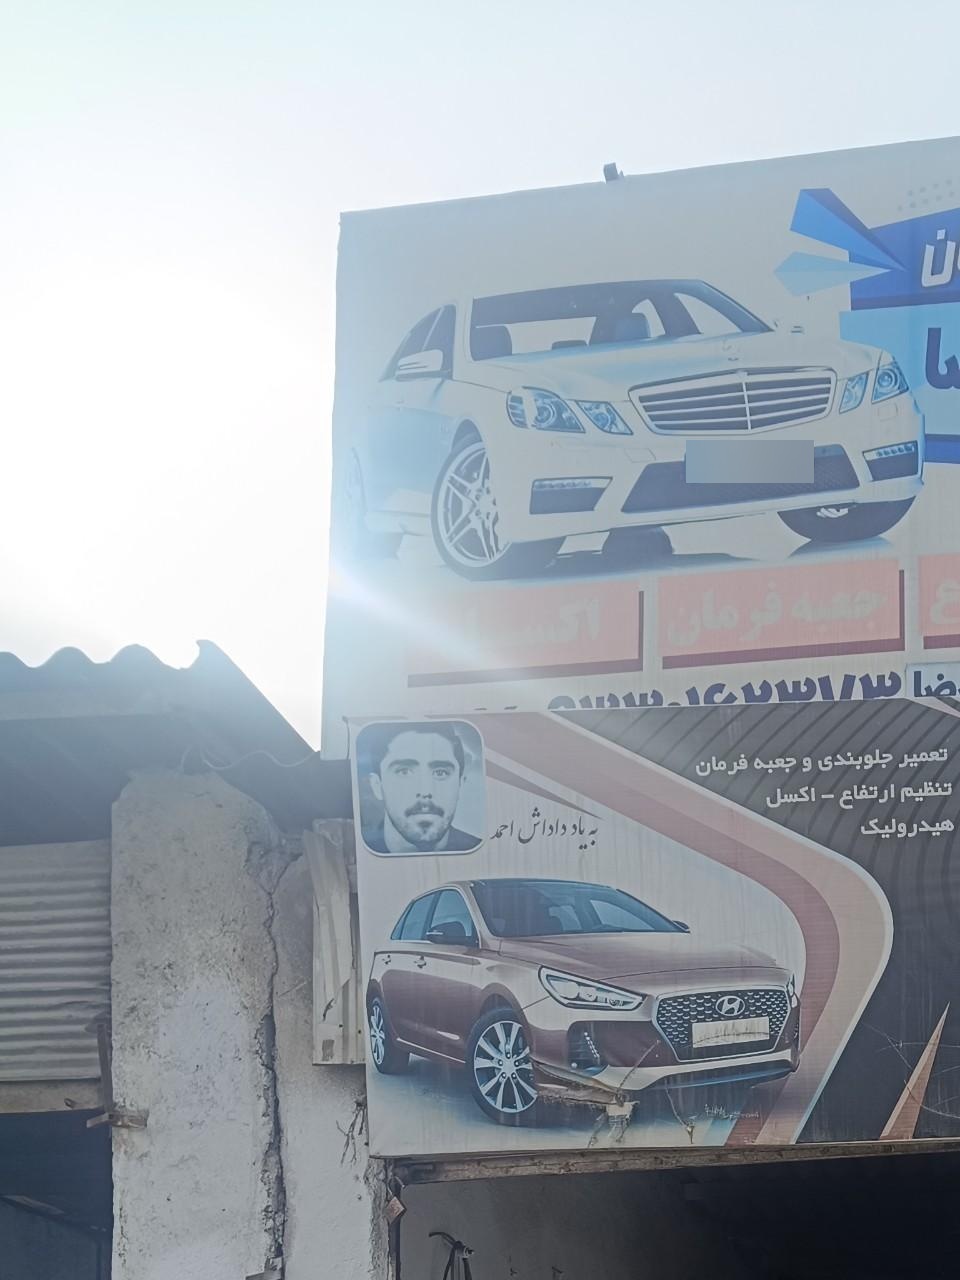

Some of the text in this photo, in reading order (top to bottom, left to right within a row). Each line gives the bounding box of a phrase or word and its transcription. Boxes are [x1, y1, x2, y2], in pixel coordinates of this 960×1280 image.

[667, 580, 783, 647] فرمان
[695, 748, 949, 776] تعمیر جلوبندی و جعبه فرمان
[766, 786, 817, 808] اکسل
[839, 784, 896, 810] ارتفاع
[900, 781, 953, 802] تنظیم
[860, 817, 956, 839] هیدرولیک
